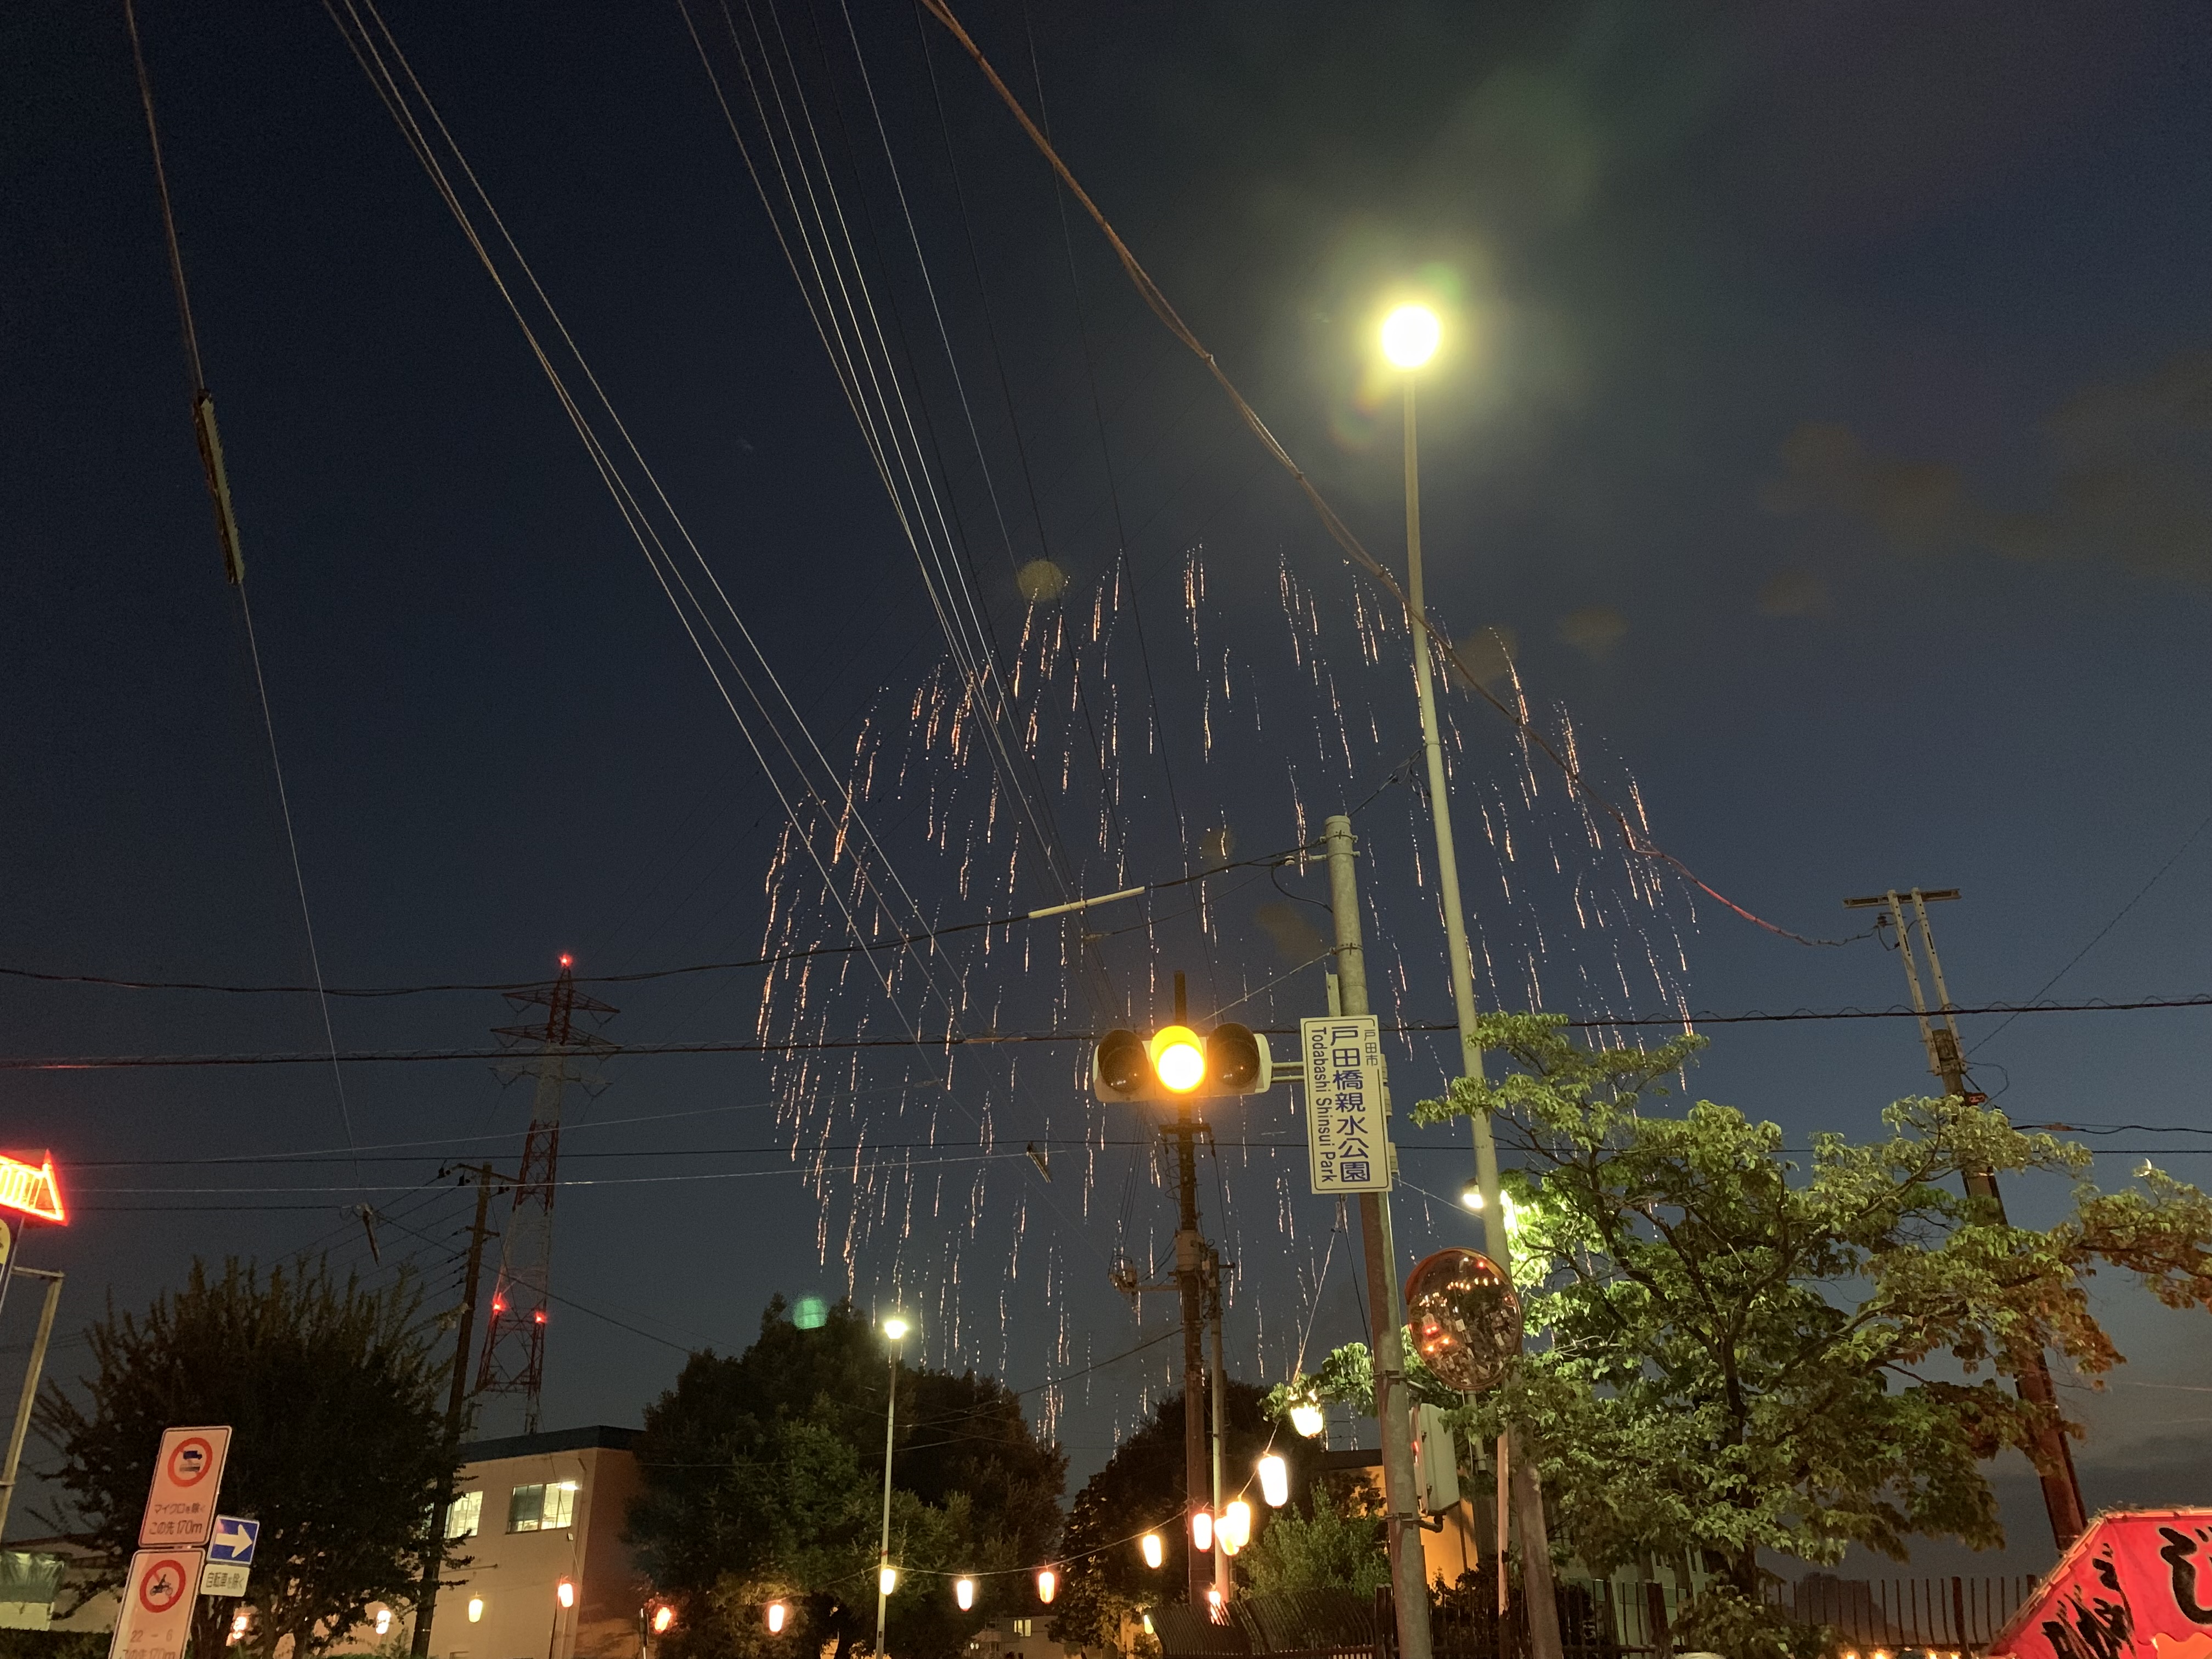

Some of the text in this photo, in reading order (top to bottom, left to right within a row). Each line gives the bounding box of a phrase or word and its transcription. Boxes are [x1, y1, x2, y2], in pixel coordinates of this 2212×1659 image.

[1364, 1029, 1378, 1066] 戸田市
[1312, 1026, 1338, 1183] Todabashi Shinsui Park
[1330, 1025, 1370, 1183] 戸田橋親水公園
[206, 1572, 245, 1589] 自転車を除く
